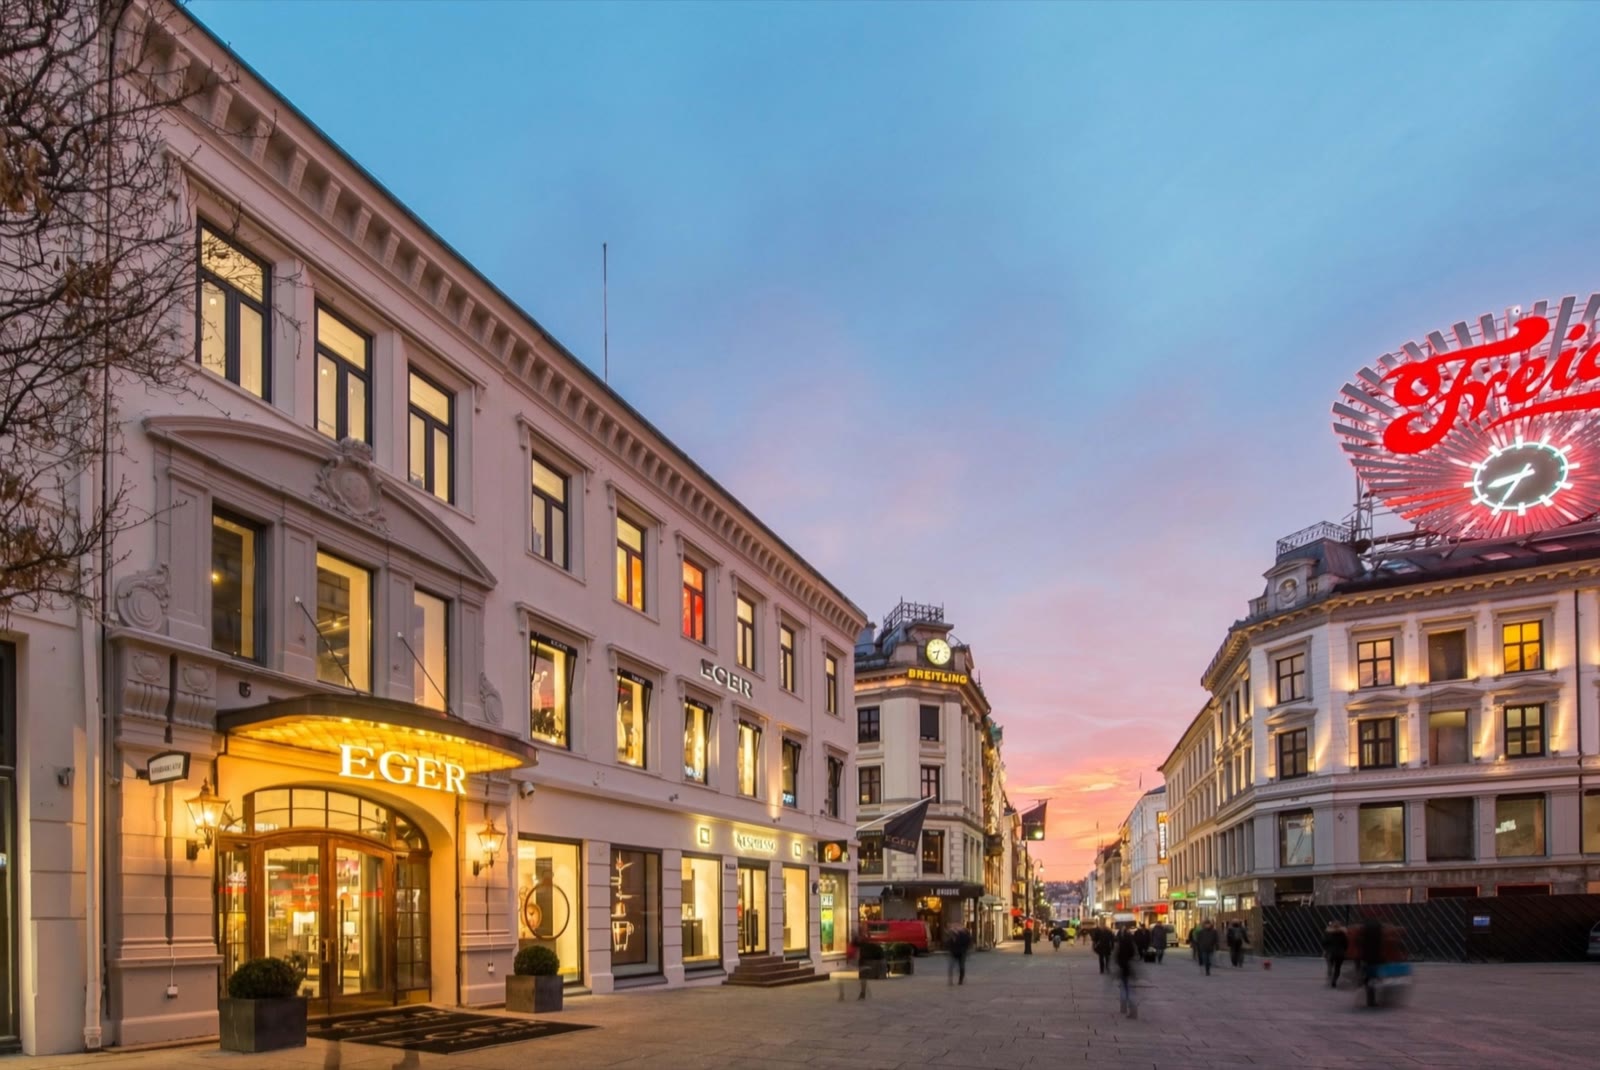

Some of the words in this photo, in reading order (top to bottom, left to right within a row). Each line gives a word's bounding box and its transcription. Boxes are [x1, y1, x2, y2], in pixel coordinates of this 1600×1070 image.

[700, 658, 753, 699] EGER
[908, 668, 968, 685] BREITLING
[339, 744, 467, 795] EGER
[884, 834, 916, 849] EGER
